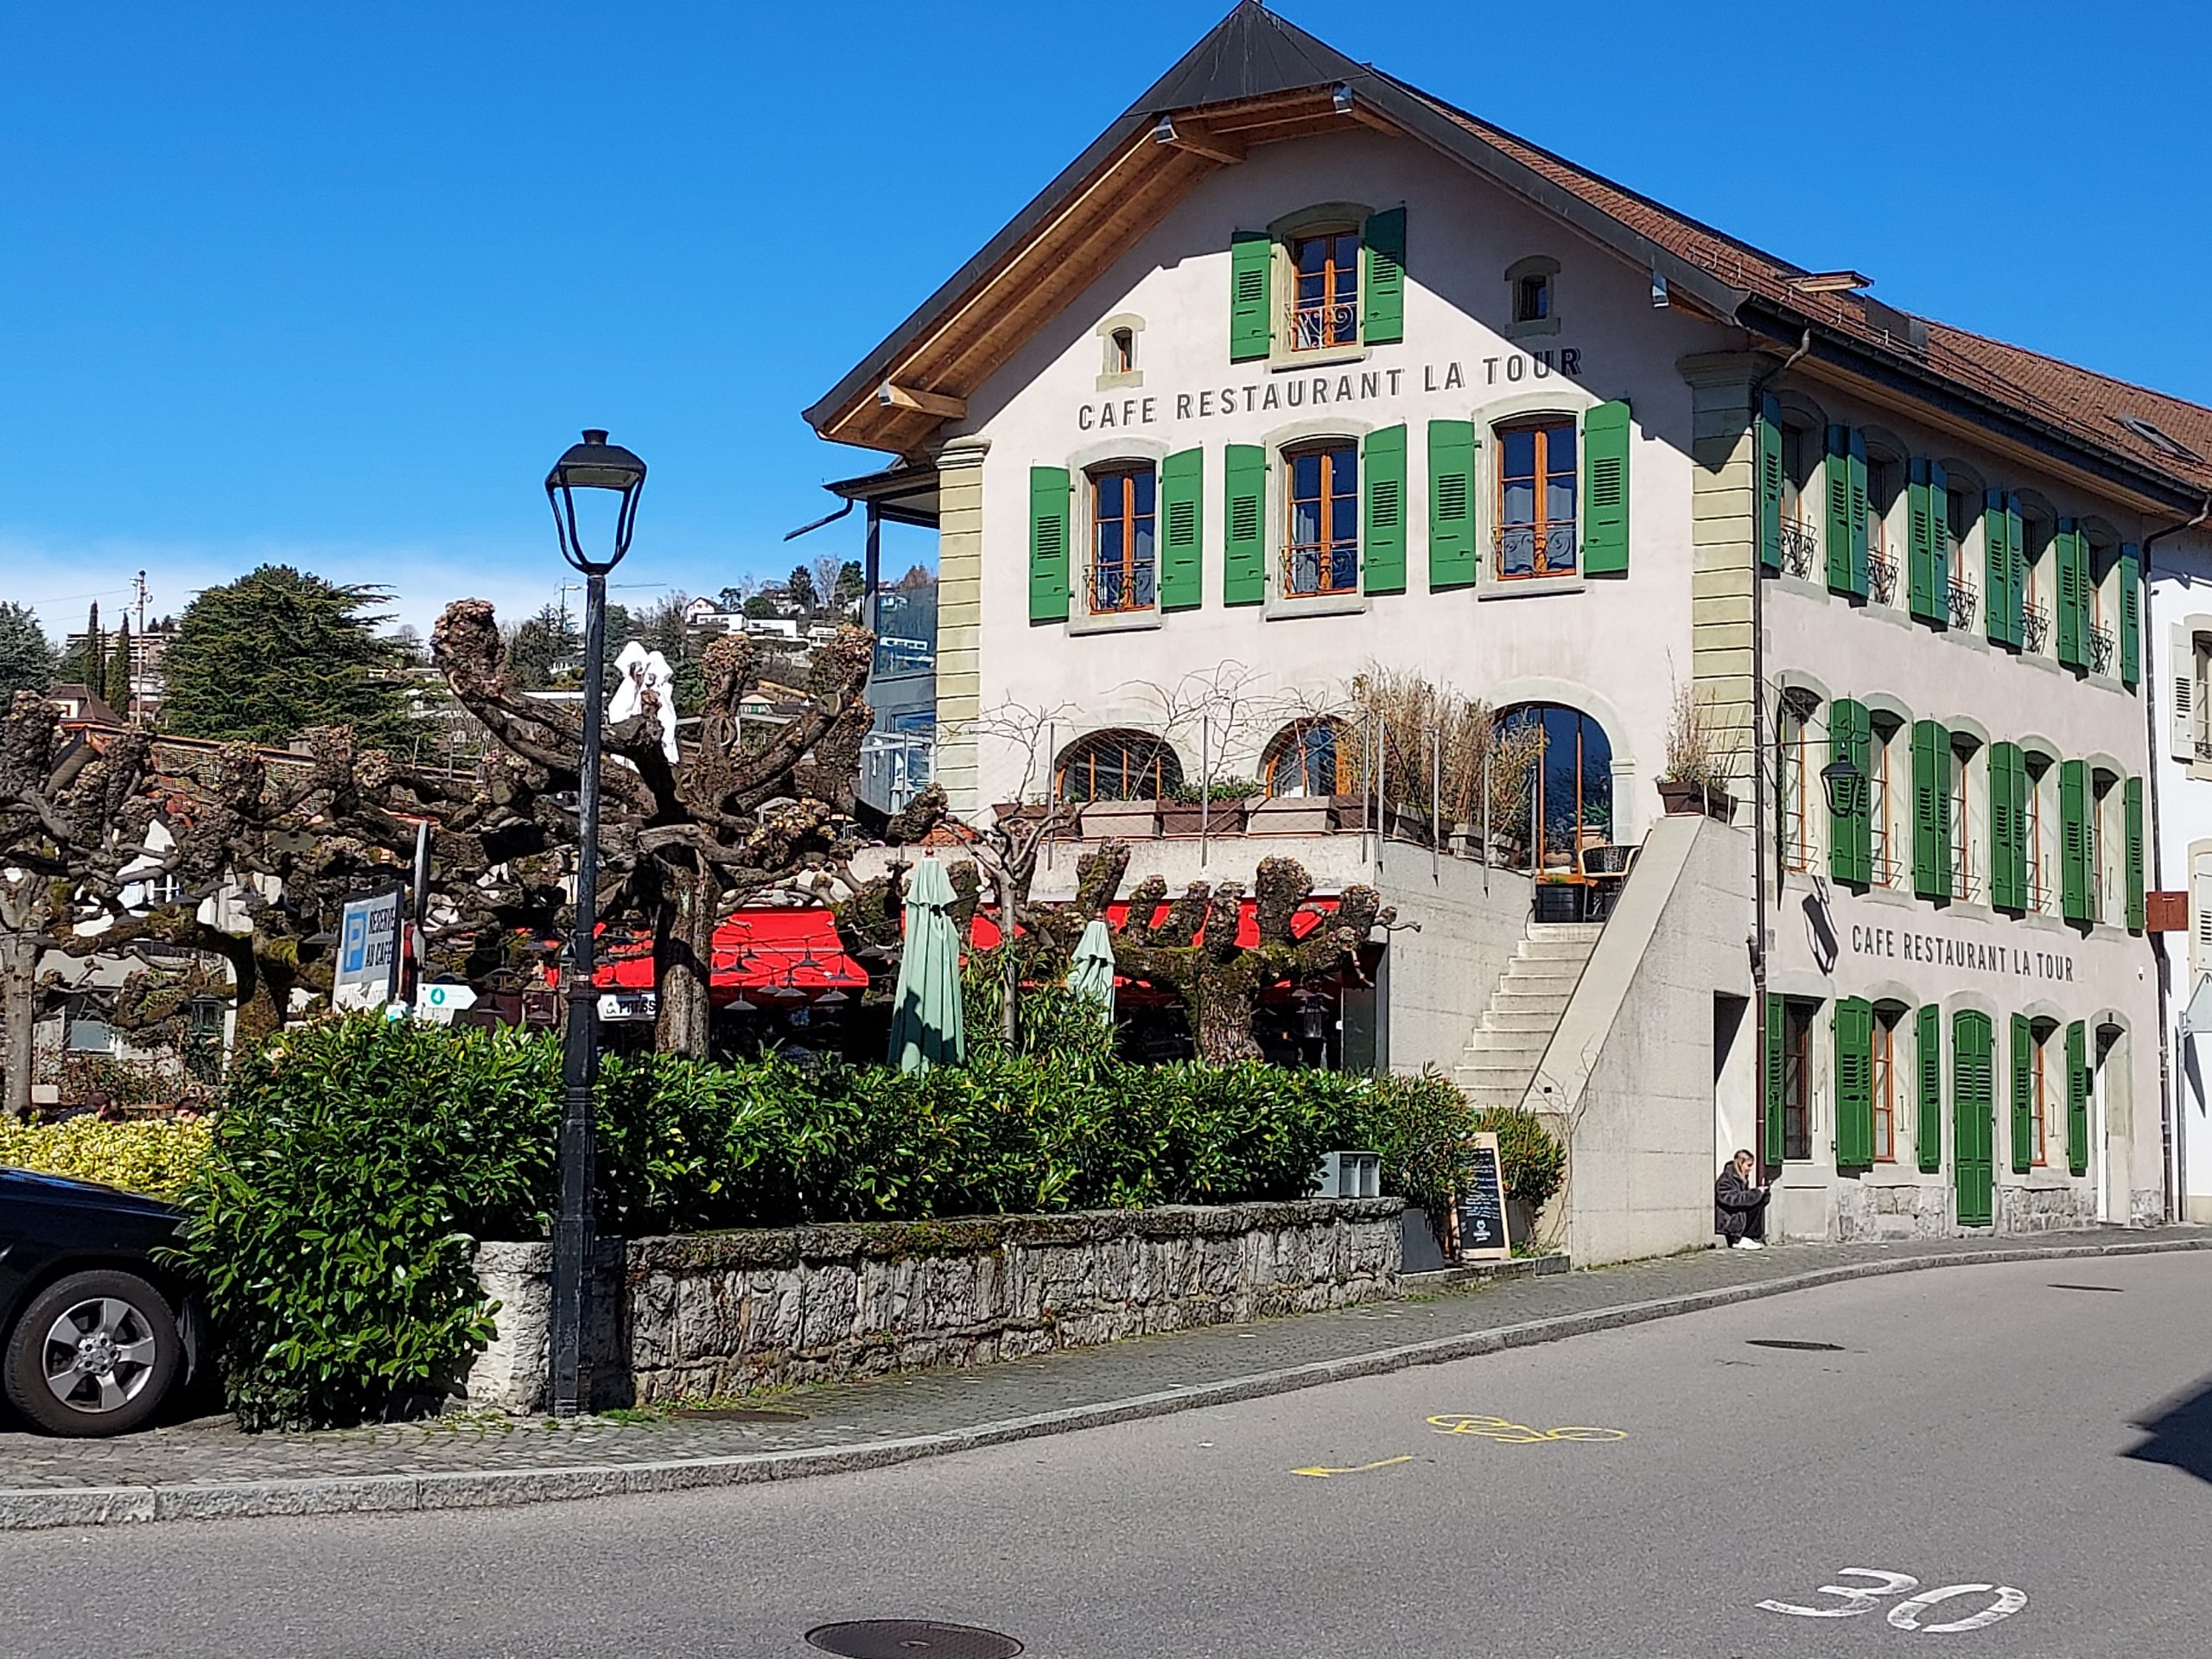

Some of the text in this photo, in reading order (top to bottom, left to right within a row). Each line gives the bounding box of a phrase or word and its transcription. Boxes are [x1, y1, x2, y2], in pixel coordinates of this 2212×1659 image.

[1078, 347, 1583, 431] CAFE RESTAURANT LA TOUR
[1852, 925, 2074, 982] CAFE RESTAURANT LA TOUR
[1755, 1567, 2029, 1633] 30
